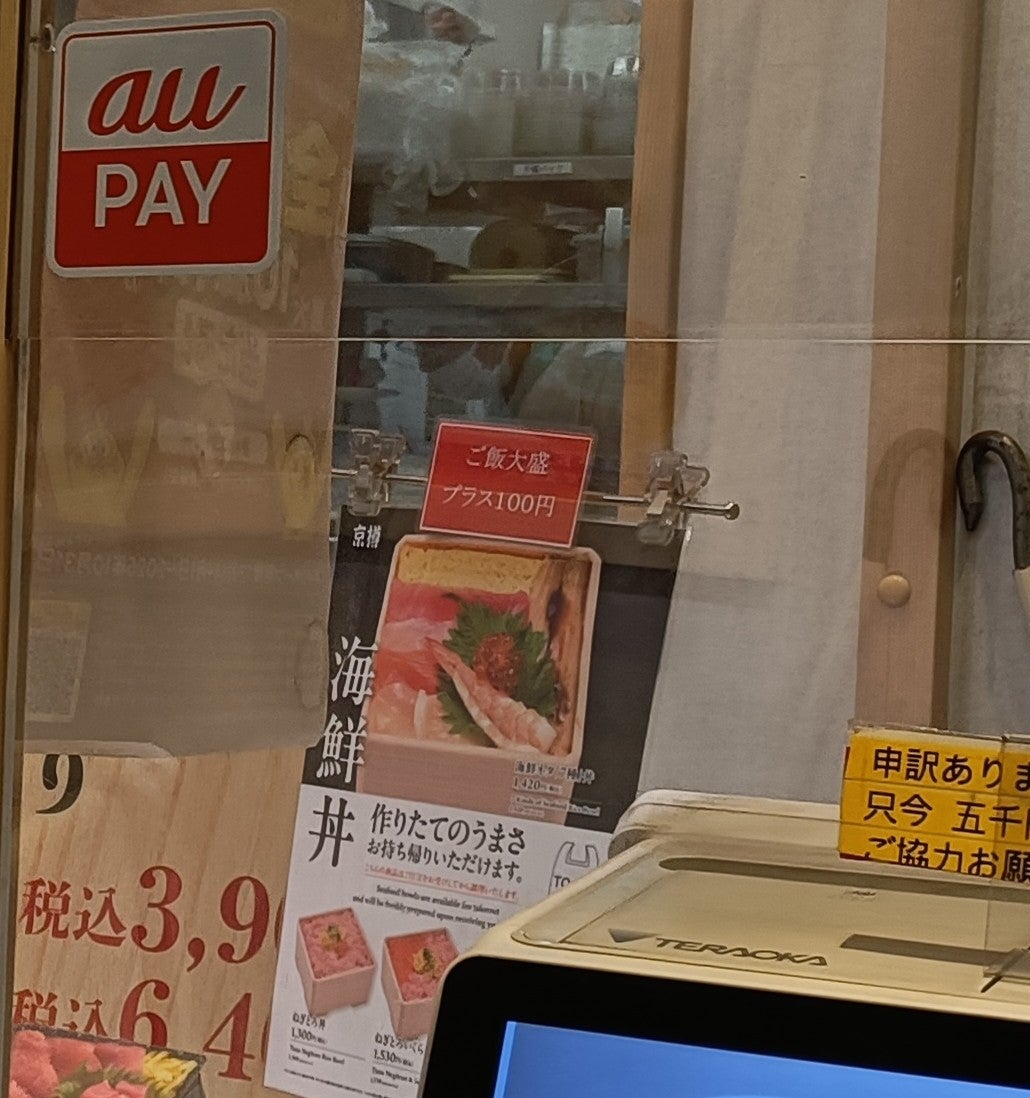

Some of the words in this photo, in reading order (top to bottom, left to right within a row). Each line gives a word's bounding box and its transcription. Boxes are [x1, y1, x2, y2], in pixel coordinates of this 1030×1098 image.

[87, 65, 246, 137] au
[94, 158, 232, 228] PAY
[465, 444, 551, 475] ご飯大盛
[442, 484, 557, 518] プラス100円
[352, 524, 382, 549] 京樽
[863, 790, 933, 826] 只今
[370, 802, 527, 856] 作りたてのうまさ
[366, 838, 523, 885] お持ち帰りいただけます。
[18, 865, 285, 973] 税込3,9
[655, 937, 828, 967] TERAOKA
